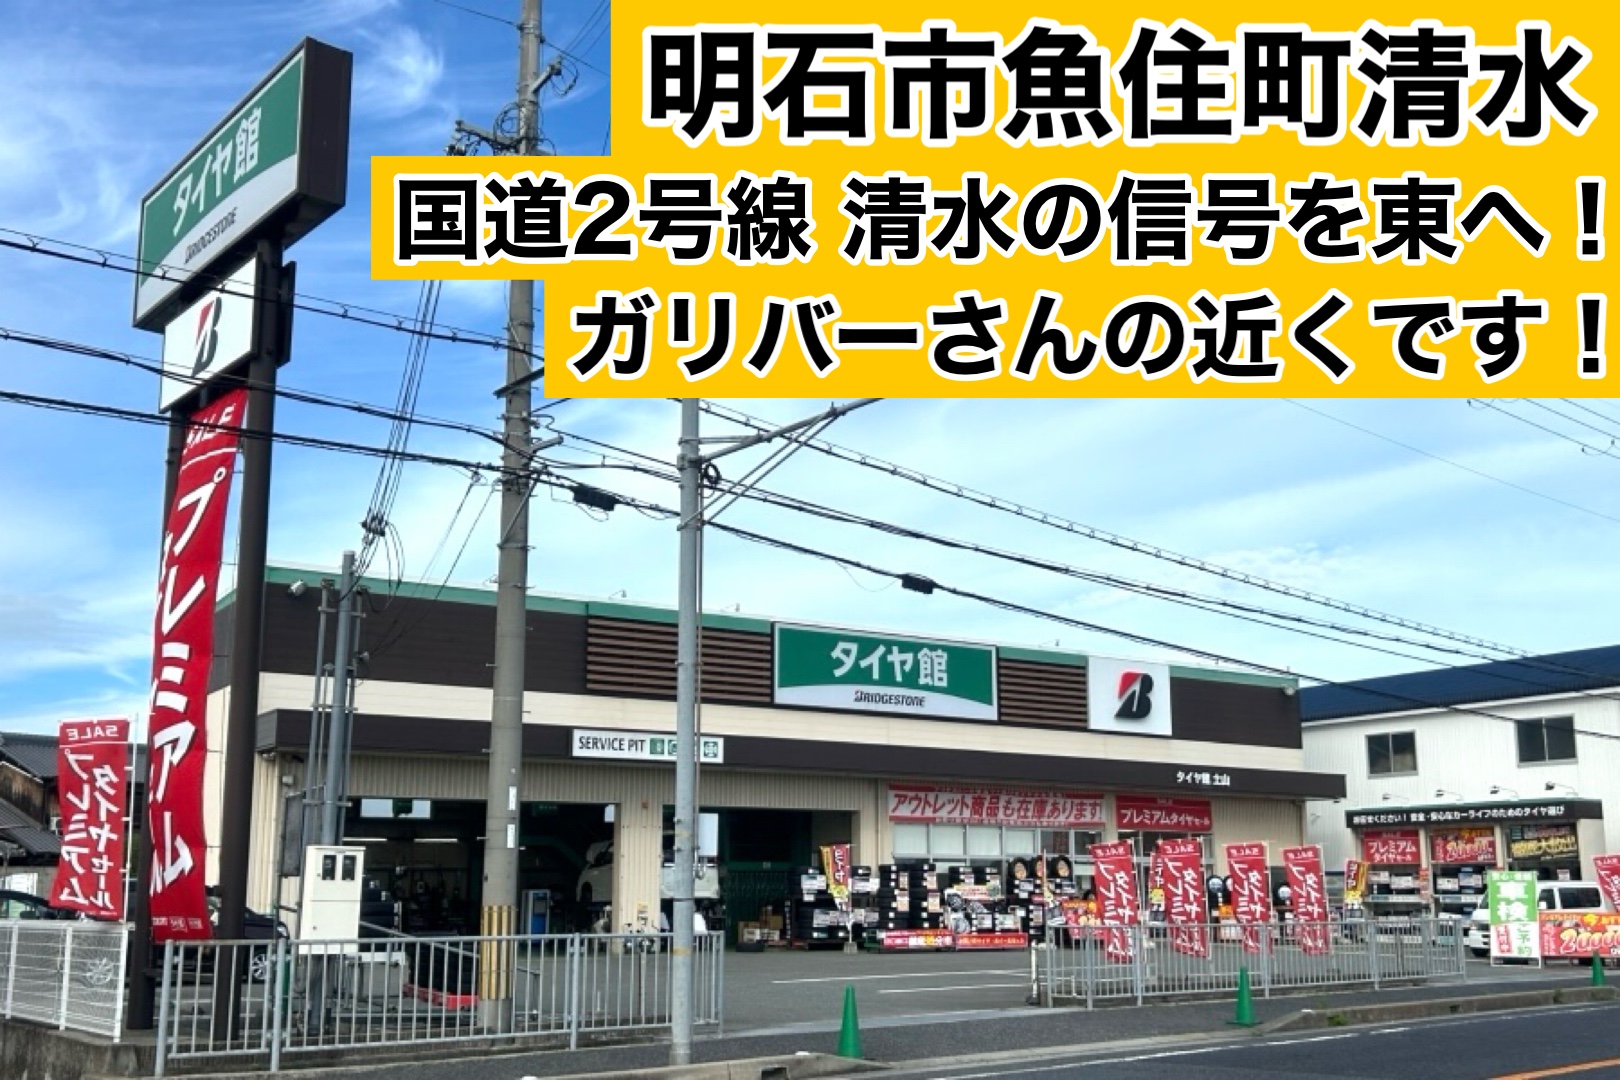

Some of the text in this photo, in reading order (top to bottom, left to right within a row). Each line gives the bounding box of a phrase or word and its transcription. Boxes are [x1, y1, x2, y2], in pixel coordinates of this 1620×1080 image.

[173, 107, 262, 237] タイヤ館
[153, 465, 227, 887] プレミアム
[830, 640, 949, 688] タイヤ館
[853, 690, 926, 708] BRIDGESTONE
[578, 735, 646, 753] SERVICE PIT
[1496, 881, 1529, 921] 車検
